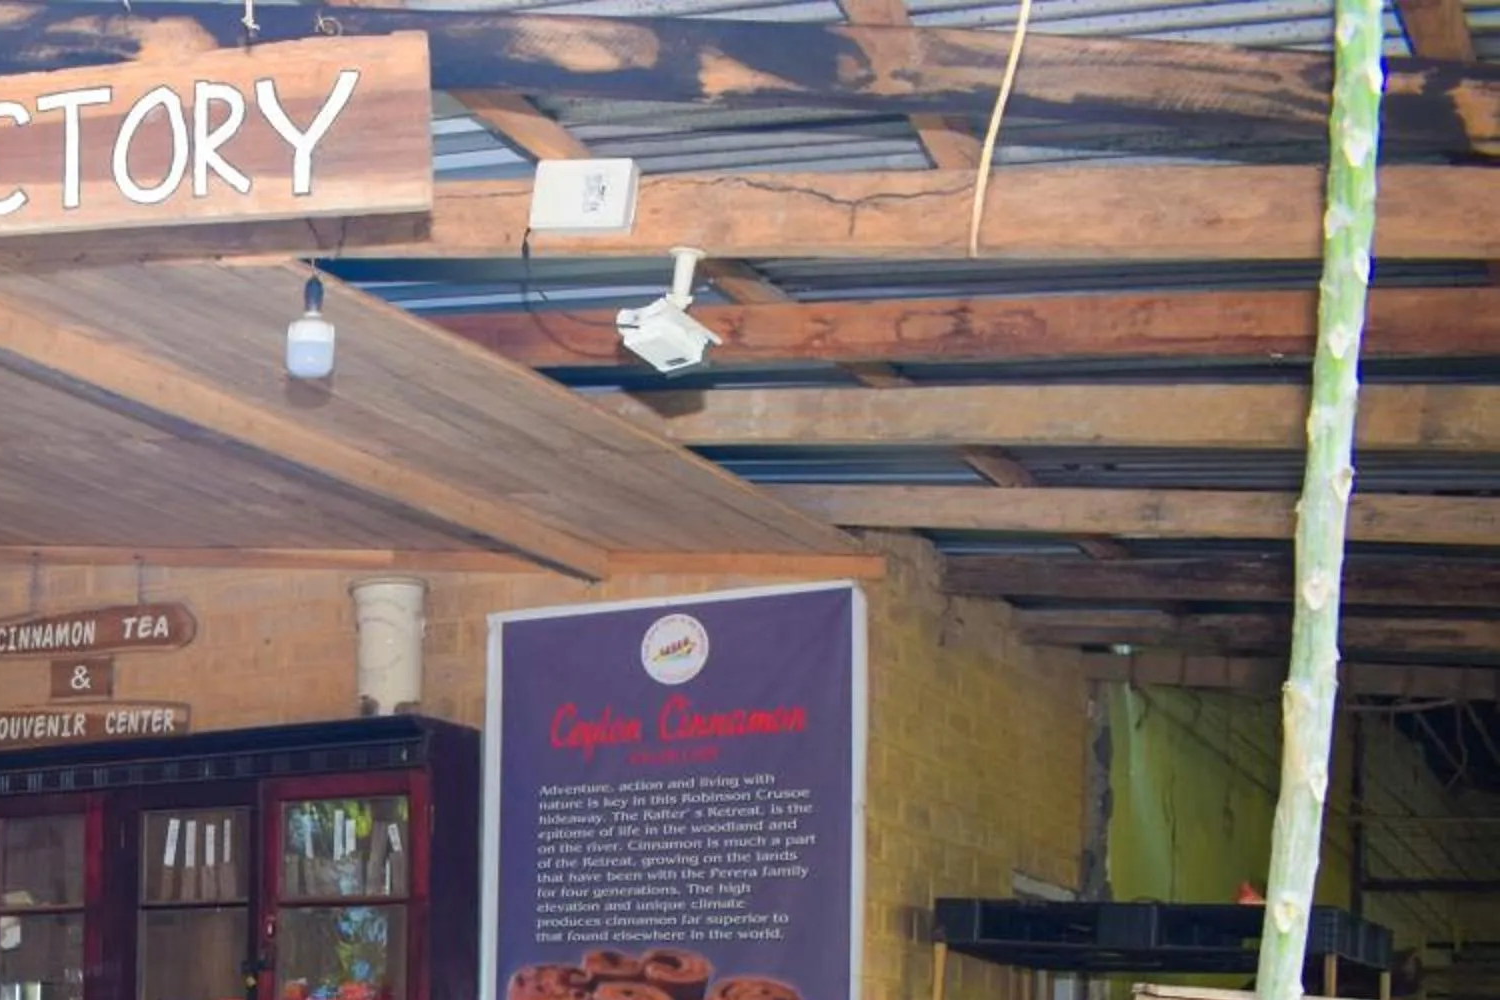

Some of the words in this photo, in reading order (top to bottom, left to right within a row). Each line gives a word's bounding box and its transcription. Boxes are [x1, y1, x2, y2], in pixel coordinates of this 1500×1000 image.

[121, 615, 170, 640] TEA
[70, 665, 92, 690] &
[104, 708, 176, 735] CENTER
[658, 692, 807, 742] Cinnamon
[619, 780, 663, 792] action
[667, 777, 695, 789] and
[700, 775, 740, 789] living
[743, 773, 775, 785] with
[539, 799, 583, 811] nature
[587, 797, 599, 809] is
[603, 796, 629, 810] key
[633, 795, 645, 807] in
[651, 793, 677, 806] this
[681, 790, 752, 804] Robinson
[755, 787, 811, 800] Crusoe
[612, 810, 639, 822] The
[770, 803, 784, 816] is
[787, 802, 813, 815] the
[538, 827, 595, 841] epitome
[599, 825, 614, 838] of
[618, 824, 641, 838] life
[645, 823, 658, 836] in
[663, 822, 687, 835] the
[691, 820, 764, 834] woodland
[768, 818, 797, 831] and
[538, 843, 555, 854] on
[559, 841, 583, 853] the
[627, 838, 703, 851] Cinnamon
[707, 836, 720, 849] is
[724, 834, 766, 847] much
[785, 833, 816, 848] part
[537, 856, 553, 869] of
[555, 856, 578, 868] the
[641, 852, 700, 870] growing
[703, 853, 722, 864] on
[727, 850, 752, 863] the
[756, 850, 799, 862] lands
[537, 871, 564, 883] that
[569, 871, 601, 882] have
[607, 869, 643, 881] been
[647, 868, 677, 880] with
[681, 868, 705, 880] the
[710, 866, 759, 878] Perera
[762, 865, 810, 880] family
[537, 886, 556, 898] for
[560, 885, 588, 897] four
[687, 882, 715, 895] The
[719, 882, 752, 897] high
[537, 901, 600, 913] elevation
[604, 900, 631, 912] and
[635, 898, 686, 913] unique
[691, 898, 746, 910] climate
[537, 915, 601, 929] produces
[605, 914, 678, 926] cinnamon
[681, 912, 701, 925] far
[706, 911, 769, 928] superior
[773, 911, 790, 924] to
[537, 931, 563, 943] that
[567, 930, 609, 941] found
[613, 928, 685, 941] elsewhere
[690, 928, 705, 940] in
[708, 928, 734, 940] the
